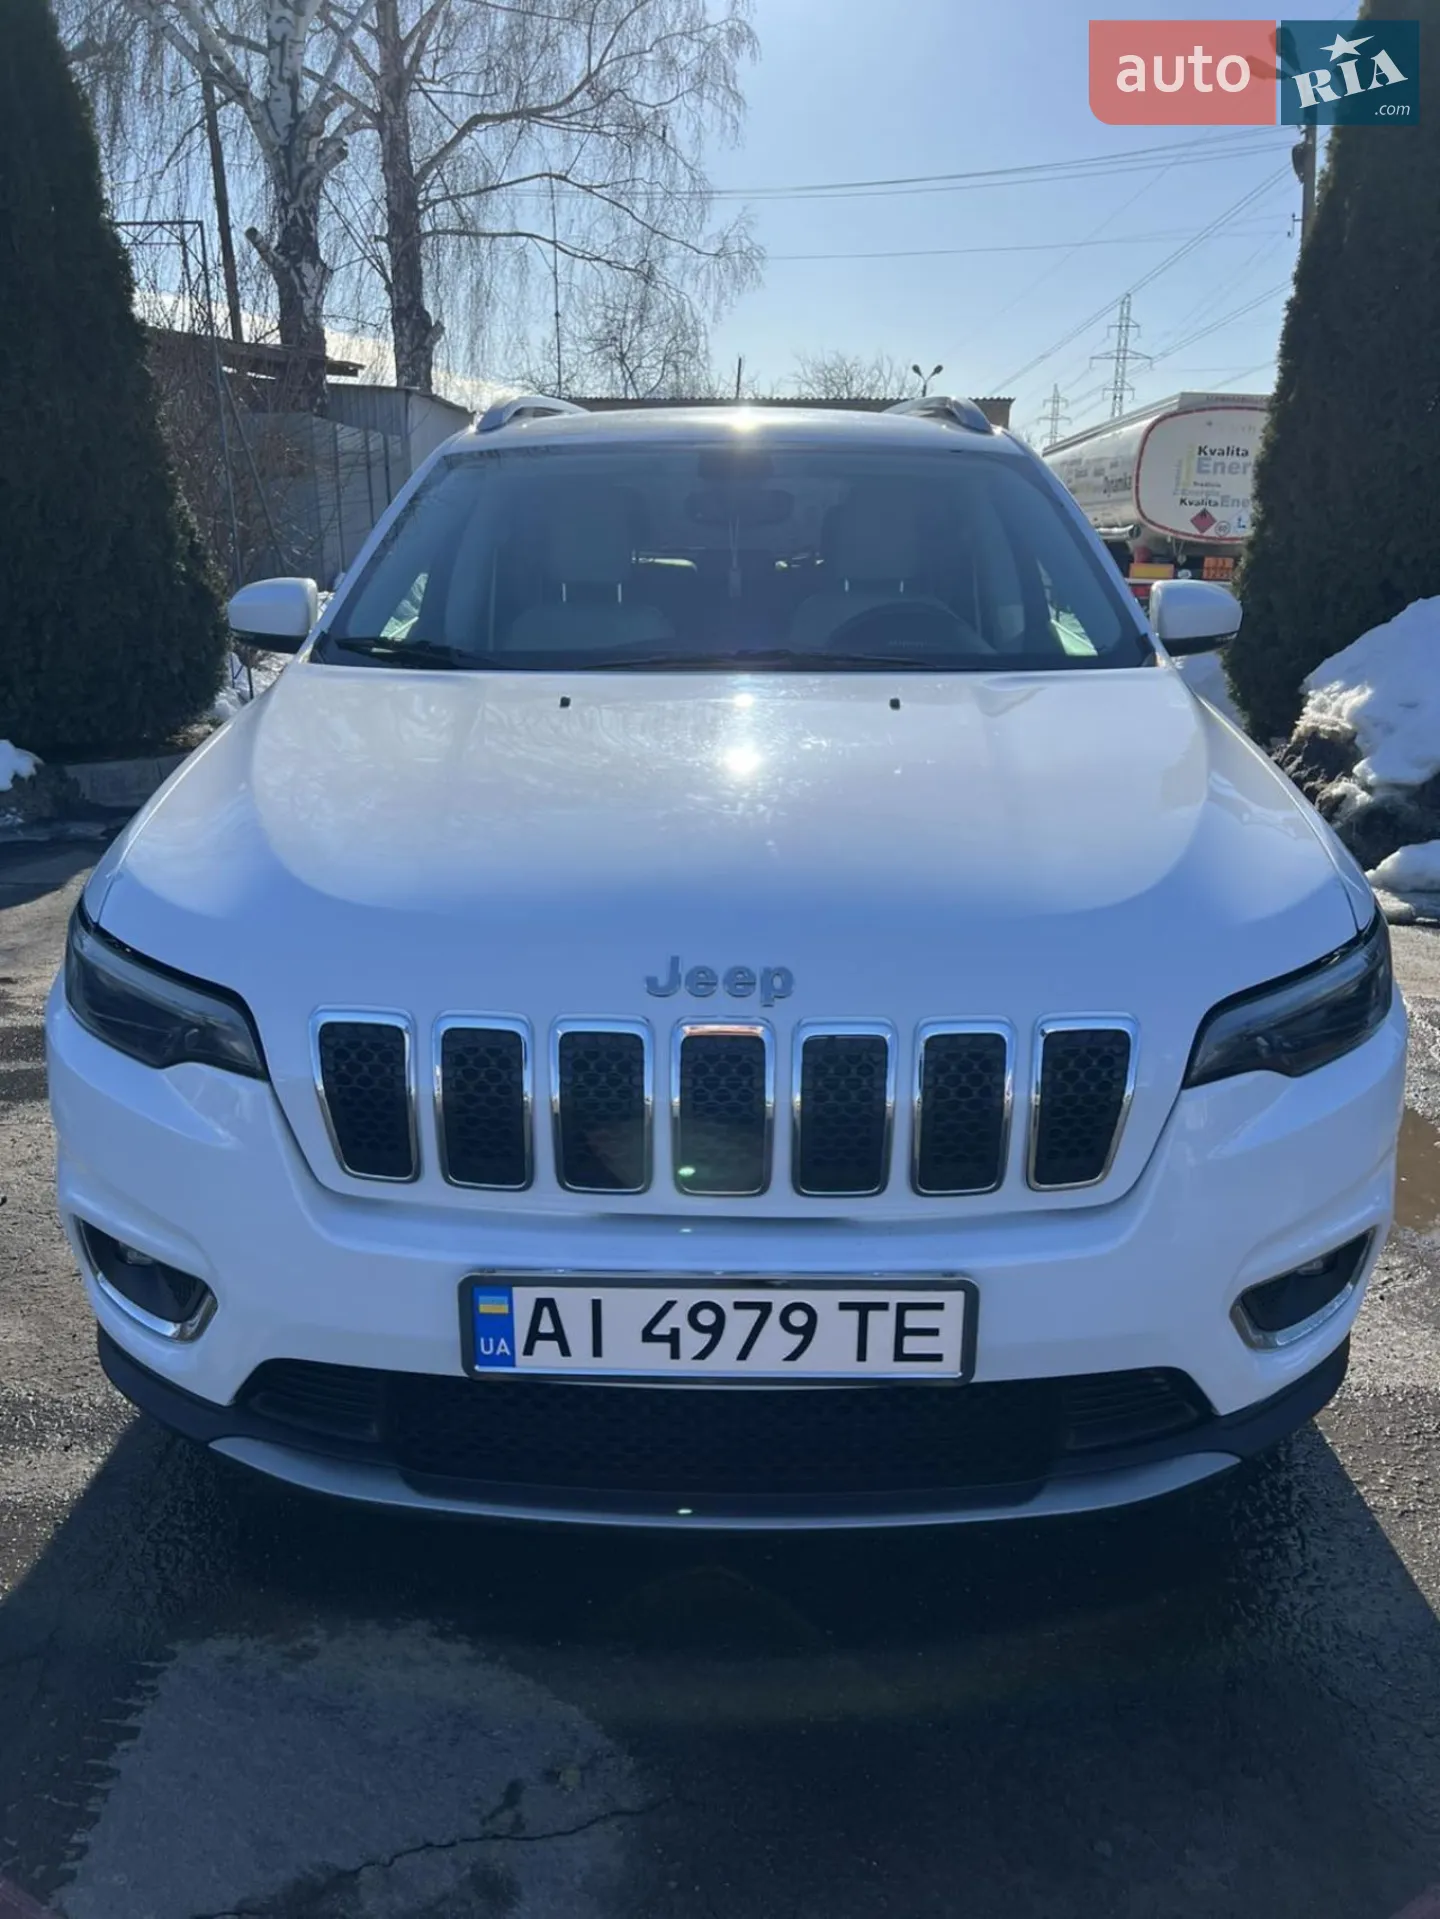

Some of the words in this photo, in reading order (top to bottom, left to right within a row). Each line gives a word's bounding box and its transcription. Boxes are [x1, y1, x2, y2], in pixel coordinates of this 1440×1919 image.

[1197, 445, 1249, 457] Kvalita
[1196, 457, 1253, 476] Ener
[1179, 497, 1219, 508] Kvalita
[1220, 495, 1251, 508] Ene
[645, 955, 795, 1008] Jeep
[522, 1297, 603, 1358] AI
[641, 1300, 819, 1362] 4979
[838, 1301, 945, 1363] TE
[479, 1337, 512, 1357] UA
